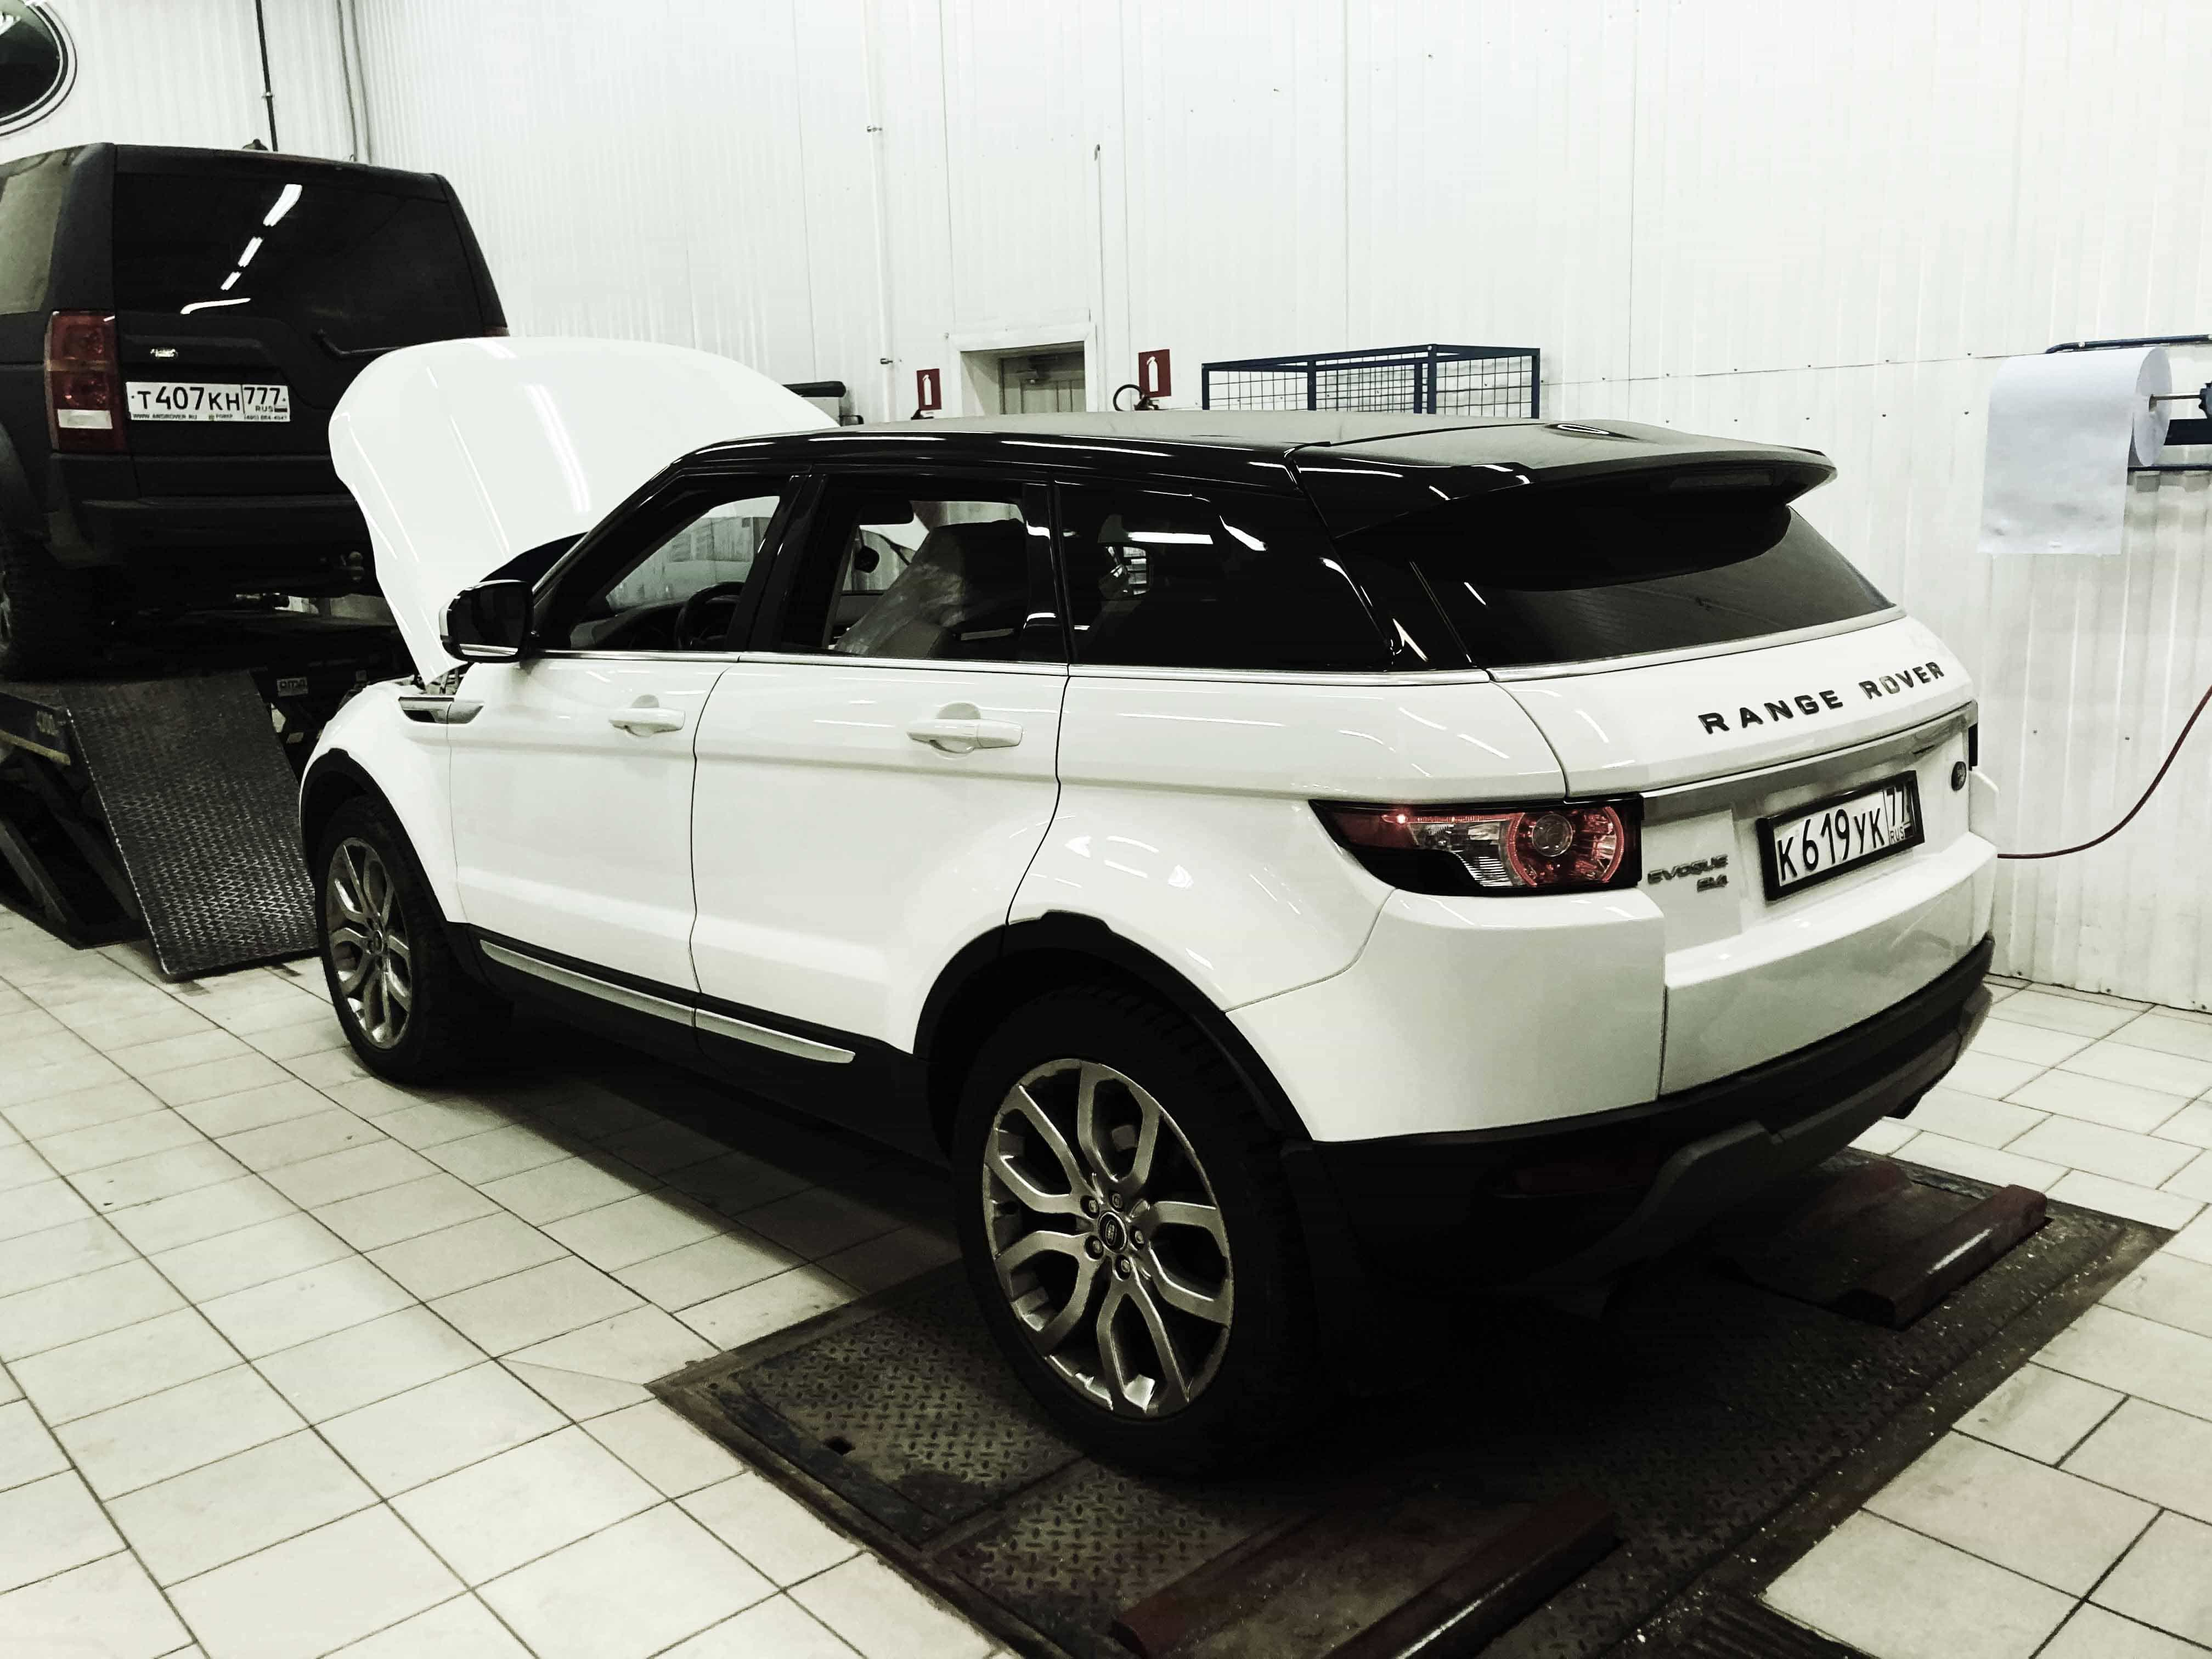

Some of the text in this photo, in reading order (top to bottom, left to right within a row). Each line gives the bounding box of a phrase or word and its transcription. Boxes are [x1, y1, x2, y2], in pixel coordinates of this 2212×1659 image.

[244, 387, 280, 405] 777
[1698, 661, 1945, 735] RANGE ROVER
[1890, 826, 1905, 844] RUS
[1647, 854, 1729, 885] EVOQUE
